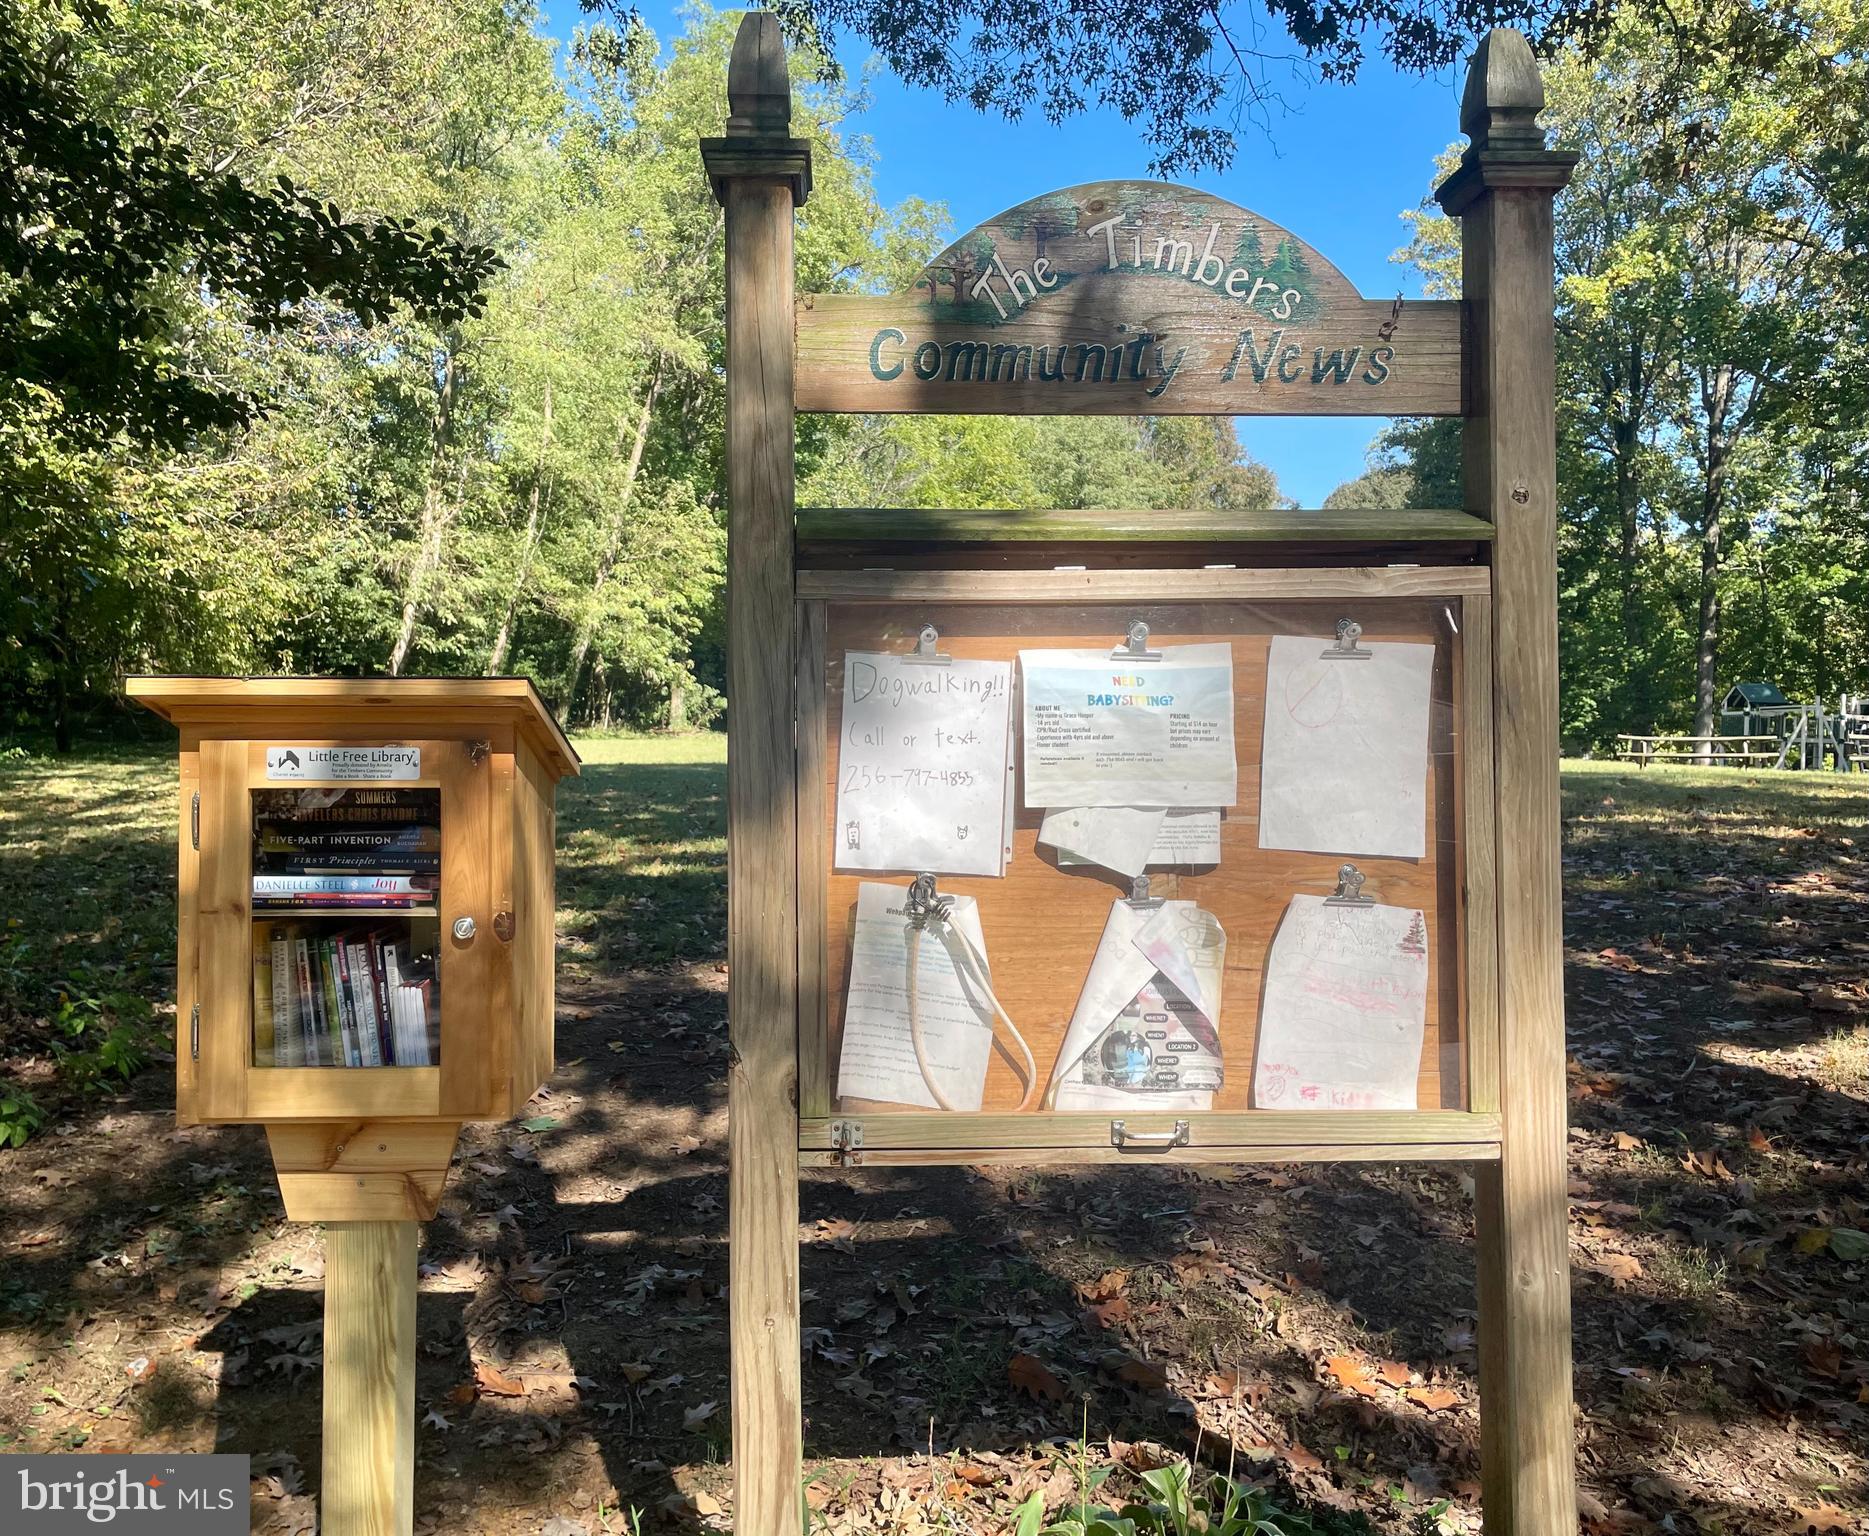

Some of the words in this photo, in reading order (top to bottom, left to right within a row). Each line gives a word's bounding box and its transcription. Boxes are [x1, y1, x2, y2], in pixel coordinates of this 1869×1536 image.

[970, 251, 1059, 321] The
[1086, 213, 1302, 322] Timbers
[868, 326, 1190, 398] Community
[1221, 327, 1396, 386] News
[852, 661, 1004, 708] Dogwalking!!
[1112, 676, 1145, 687] NEED
[849, 721, 884, 747] Call
[904, 734, 917, 747] or
[308, 750, 339, 762] Little
[343, 750, 368, 762] Free
[371, 750, 413, 766] Library
[355, 791, 397, 805] SUMMERS
[270, 835, 324, 845] FIVE-PART
[330, 835, 391, 845] INVENTION
[329, 855, 377, 867] Principles
[255, 880, 311, 890] DANIELLE
[315, 879, 346, 890] STEEL
[371, 878, 398, 891] Joy
[358, 943, 370, 981] LOVE
